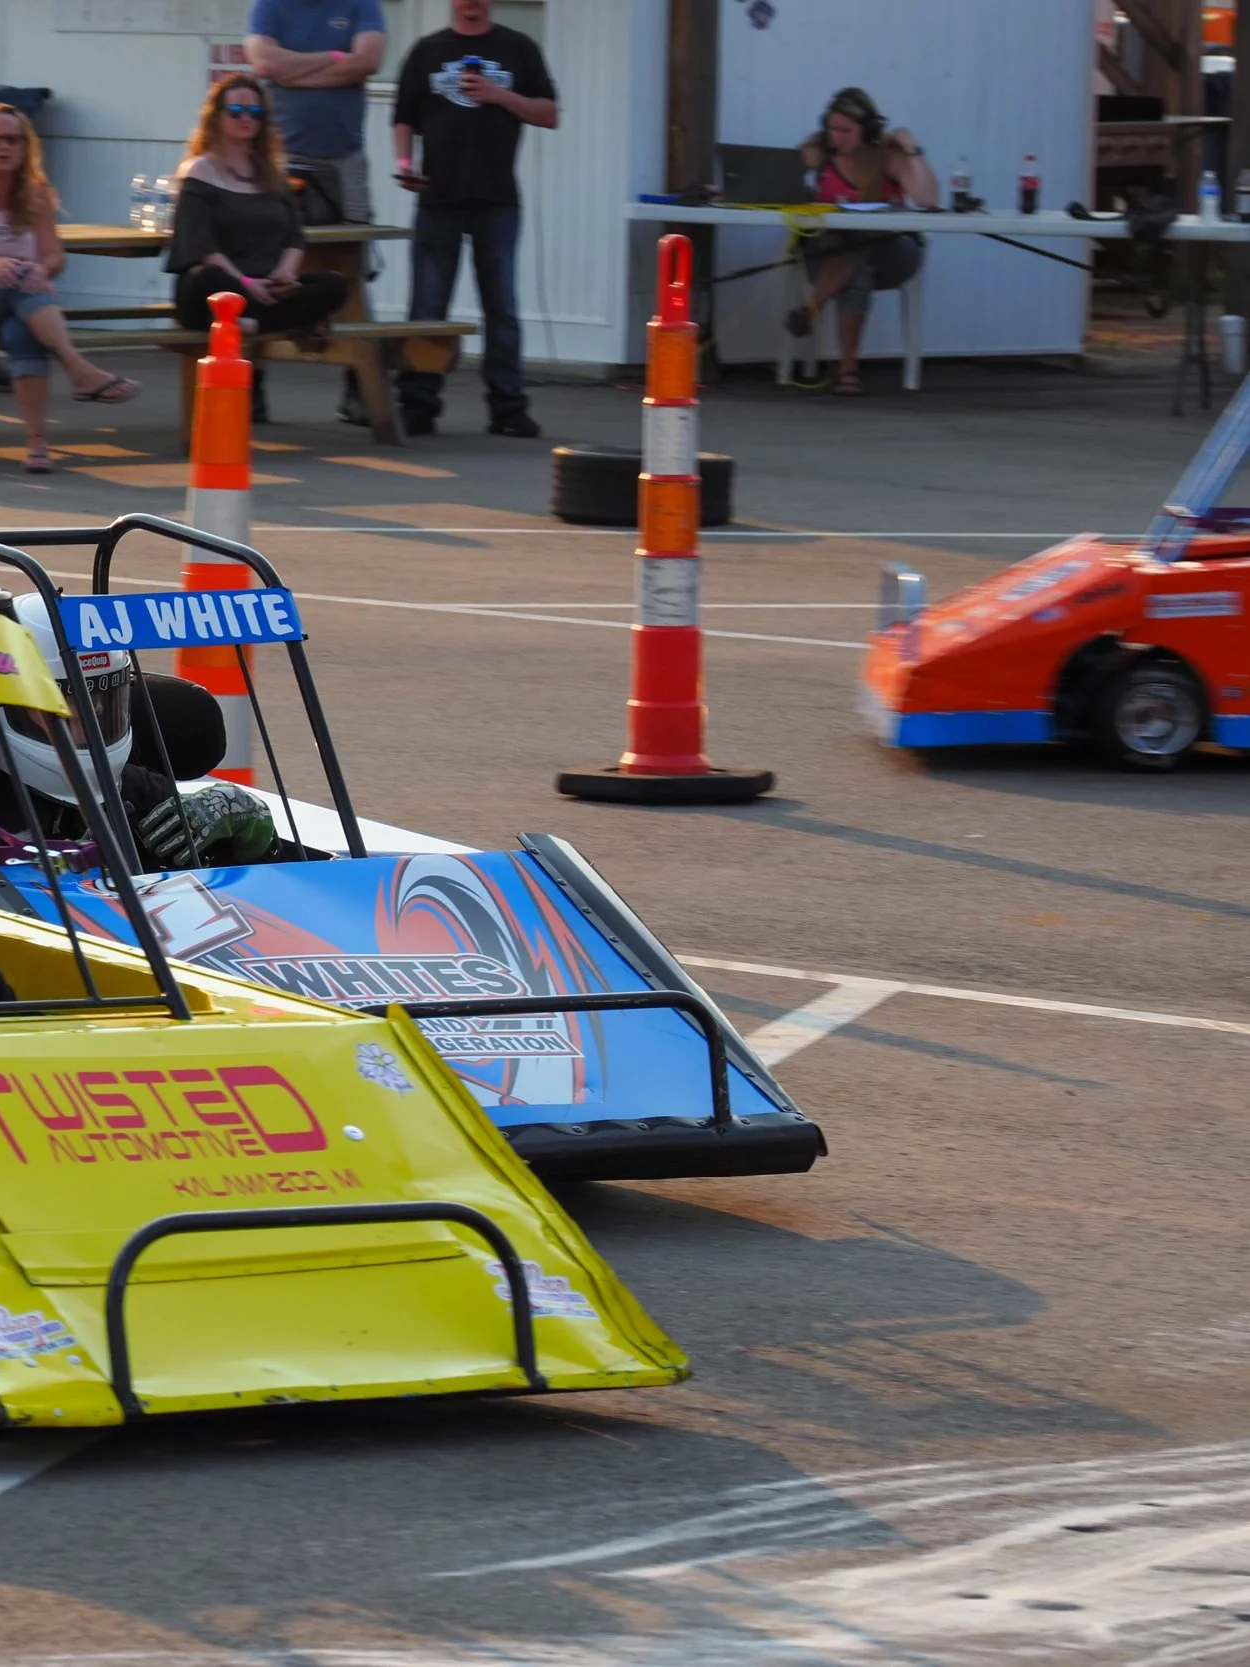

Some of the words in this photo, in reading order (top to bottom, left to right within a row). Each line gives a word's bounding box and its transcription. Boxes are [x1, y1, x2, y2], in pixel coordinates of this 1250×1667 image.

[79, 600, 134, 649] AJ
[144, 593, 294, 640] WHITE
[250, 956, 522, 998] WHITES
[47, 1128, 267, 1164] AUTOMOTIVE
